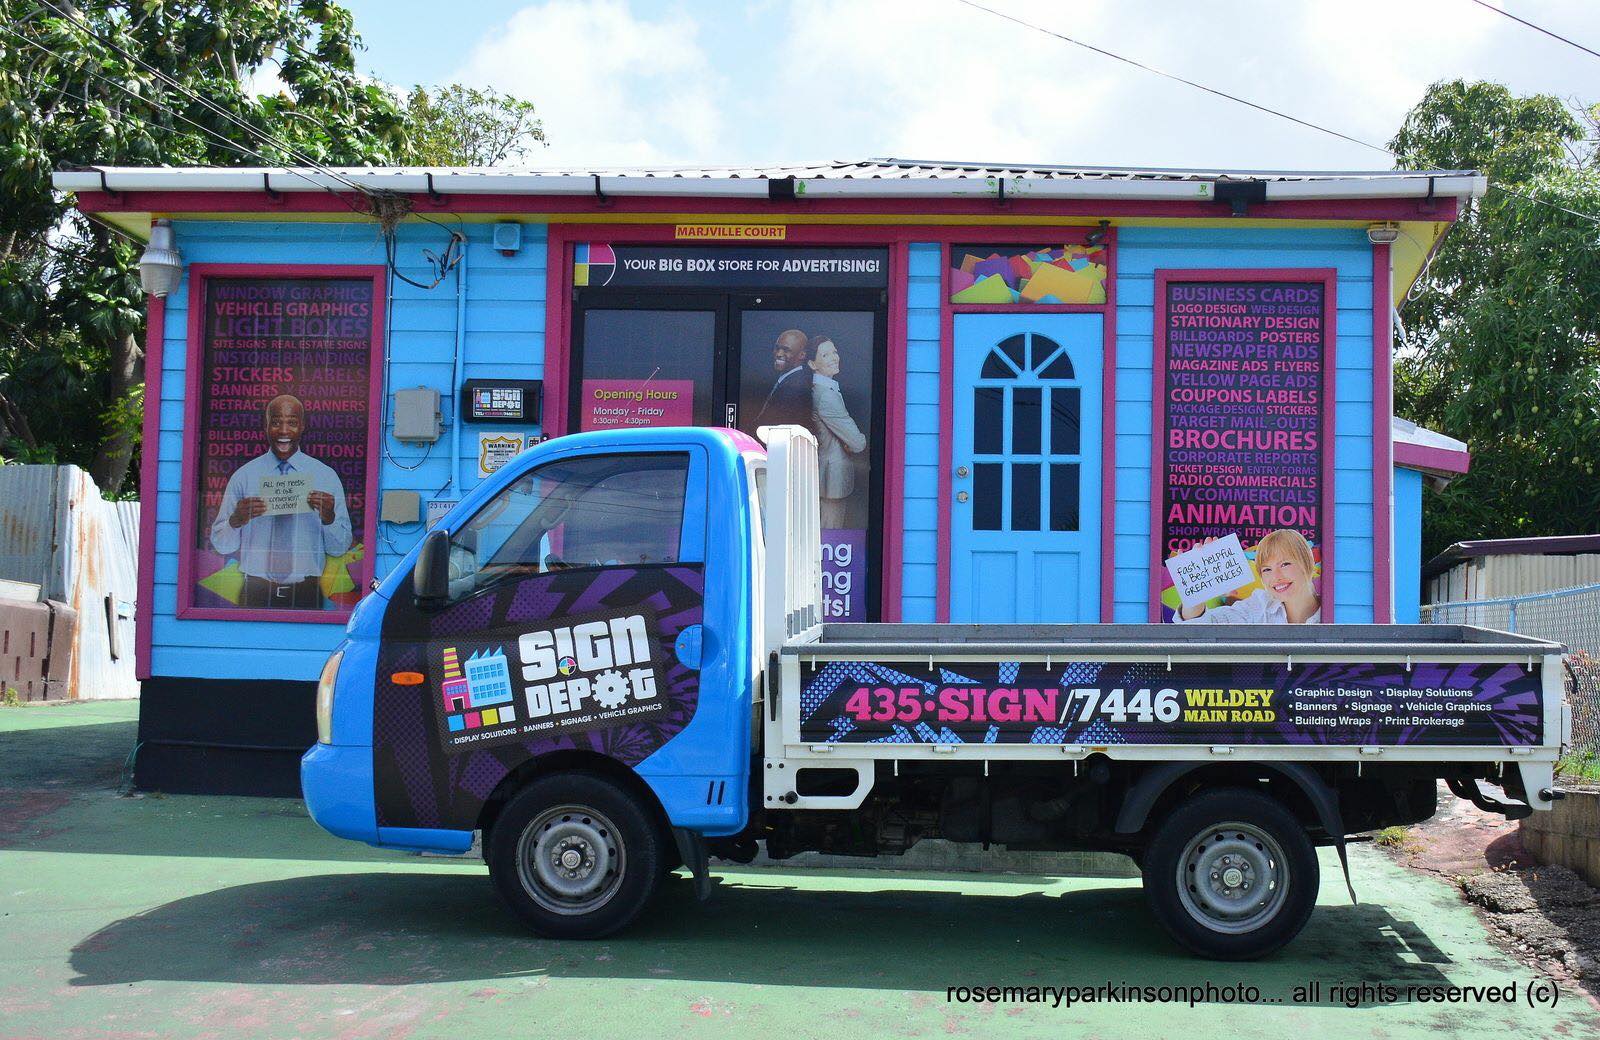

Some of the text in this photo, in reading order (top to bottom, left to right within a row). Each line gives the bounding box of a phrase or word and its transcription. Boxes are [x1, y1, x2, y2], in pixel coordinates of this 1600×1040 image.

[677, 227, 784, 236] MARJVILLE COURT
[624, 259, 880, 273] YOUR BIG BOX STORE FOR ADVERTISING!
[216, 287, 369, 300] WINDOW GRAPHICS
[1172, 287, 1320, 303] BUSINESS CARDS
[215, 302, 369, 317] VEHICLE GRAPHICS
[1171, 304, 1320, 314] LOGO DESIGN WEB DESIGN
[214, 318, 368, 338] LIGHT BOXES
[1171, 316, 1320, 329] STATIONARY DESIGN
[1170, 330, 1320, 344] BILLBOARDS POSTERS
[212, 340, 368, 350] SITE SIGNS REAL ESTATE SIGNS
[1170, 344, 1319, 359] NEWSPAPER ADS
[214, 352, 367, 366] INSTORE BRANDING
[1170, 360, 1320, 372] MAGAZINE ADS FLYERS
[212, 367, 366, 382] STICKERS LABELS
[1170, 373, 1318, 388] YELLOW PAGE ADS
[210, 384, 279, 396] BANNERS
[300, 384, 367, 396] BANNERS
[594, 388, 678, 402] Opening Hours
[1170, 388, 1318, 404] COUPONS LABELS
[210, 399, 366, 412] RETRACT BANNERS
[594, 407, 630, 416] Monday
[638, 407, 664, 416] Friday
[1170, 404, 1318, 416] PACKAGE DESIGN STICKERS
[209, 413, 365, 428] FEATH NNERS
[1170, 416, 1226, 428] TARGET
[208, 430, 266, 440] BILLBOAR
[326, 432, 365, 442] BOXES
[1169, 429, 1318, 450] BROCHURES
[304, 444, 364, 458] UTIONS
[1168, 451, 1317, 464] CORPORATE REPORTS
[1169, 464, 1316, 475] TICKET DESIGN ENTRY FORMS
[1169, 474, 1316, 488] RADIO COMMERCIALS
[1168, 488, 1316, 504] TV COMMERCIALS
[1168, 504, 1316, 526] ANIMATION
[1168, 526, 1200, 536] SHOP
[1202, 527, 1242, 537] WRAPS
[1244, 528, 1272, 537] ITEM
[1212, 562, 1221, 574] of
[1184, 578, 1214, 596] GREAT
[1184, 689, 1274, 707] WILDEY
[1294, 688, 1473, 698] Graphic Design Display Solutions
[1295, 702, 1492, 712] Banners Signage Vehicle Graphics
[1184, 710, 1276, 722] MAIN ROAD
[1295, 716, 1464, 727] Building Wraps Print Brokerage
[454, 703, 662, 744] DISPLAY SOLUTIONS BANNERS SIGNAGE VEHICLE GRAPHICS
